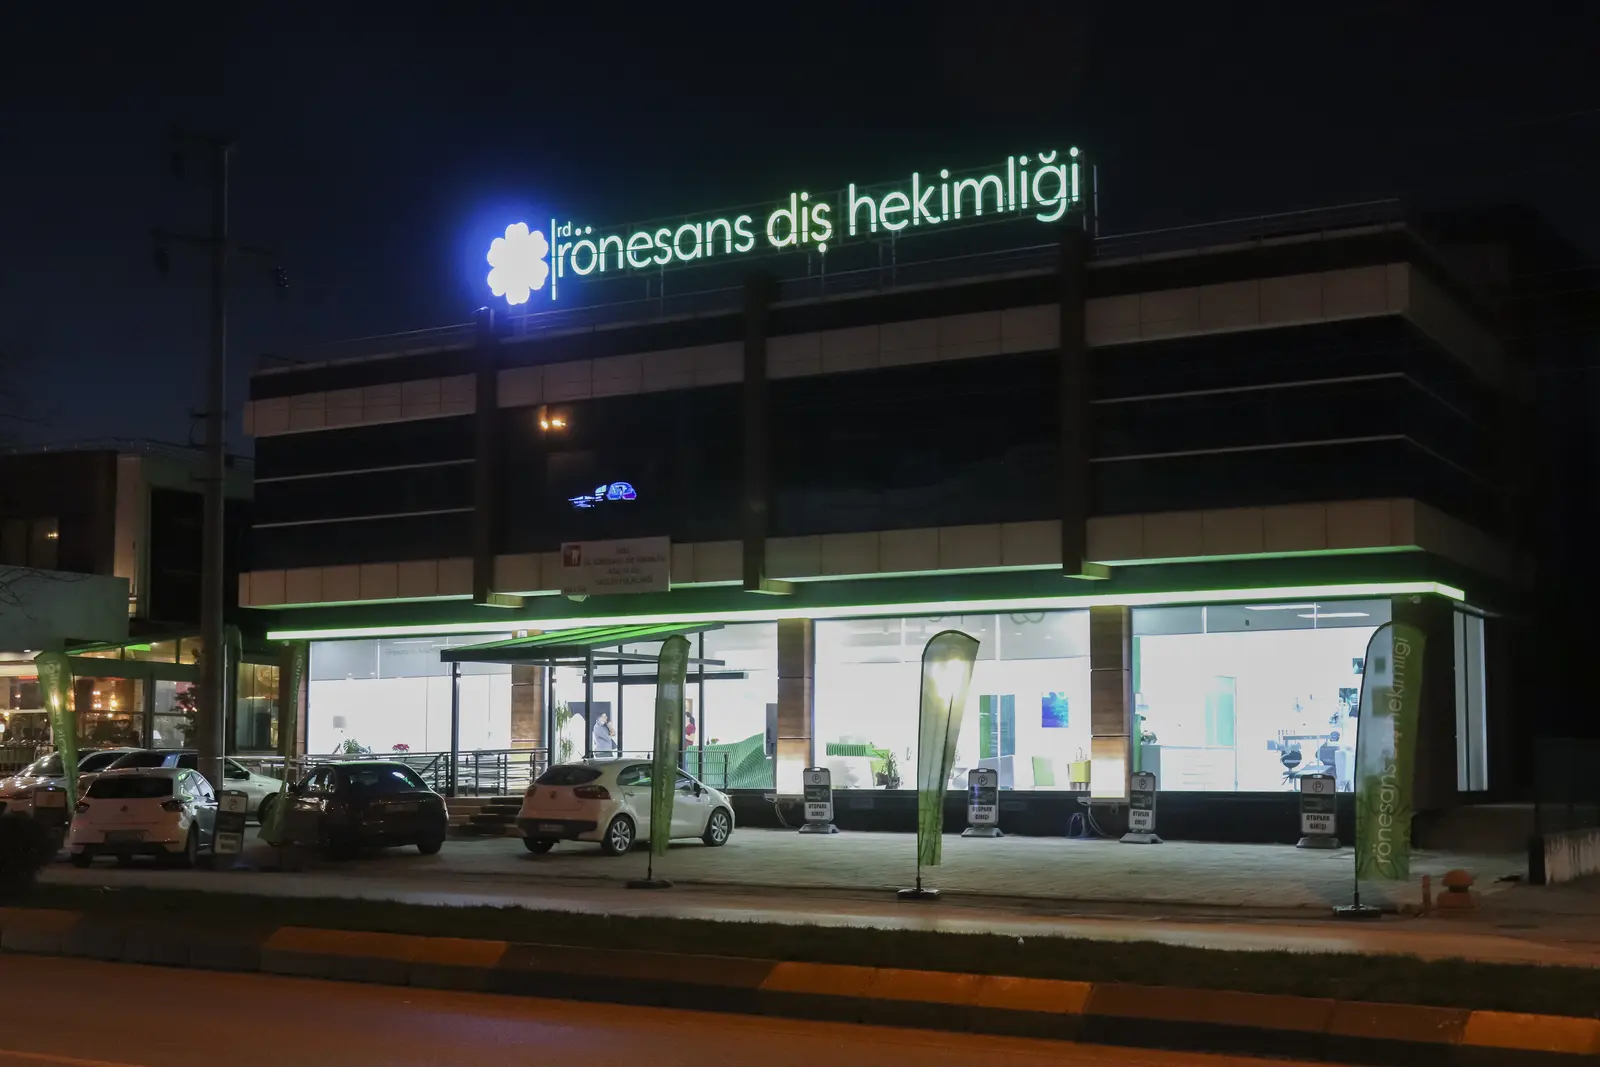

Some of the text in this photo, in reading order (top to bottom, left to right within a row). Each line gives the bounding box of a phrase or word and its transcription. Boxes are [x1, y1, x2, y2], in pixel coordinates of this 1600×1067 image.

[557, 221, 571, 237] rd
[558, 146, 1079, 278] rönesans diş hekimliği
[1372, 766, 1398, 864] rönesans
